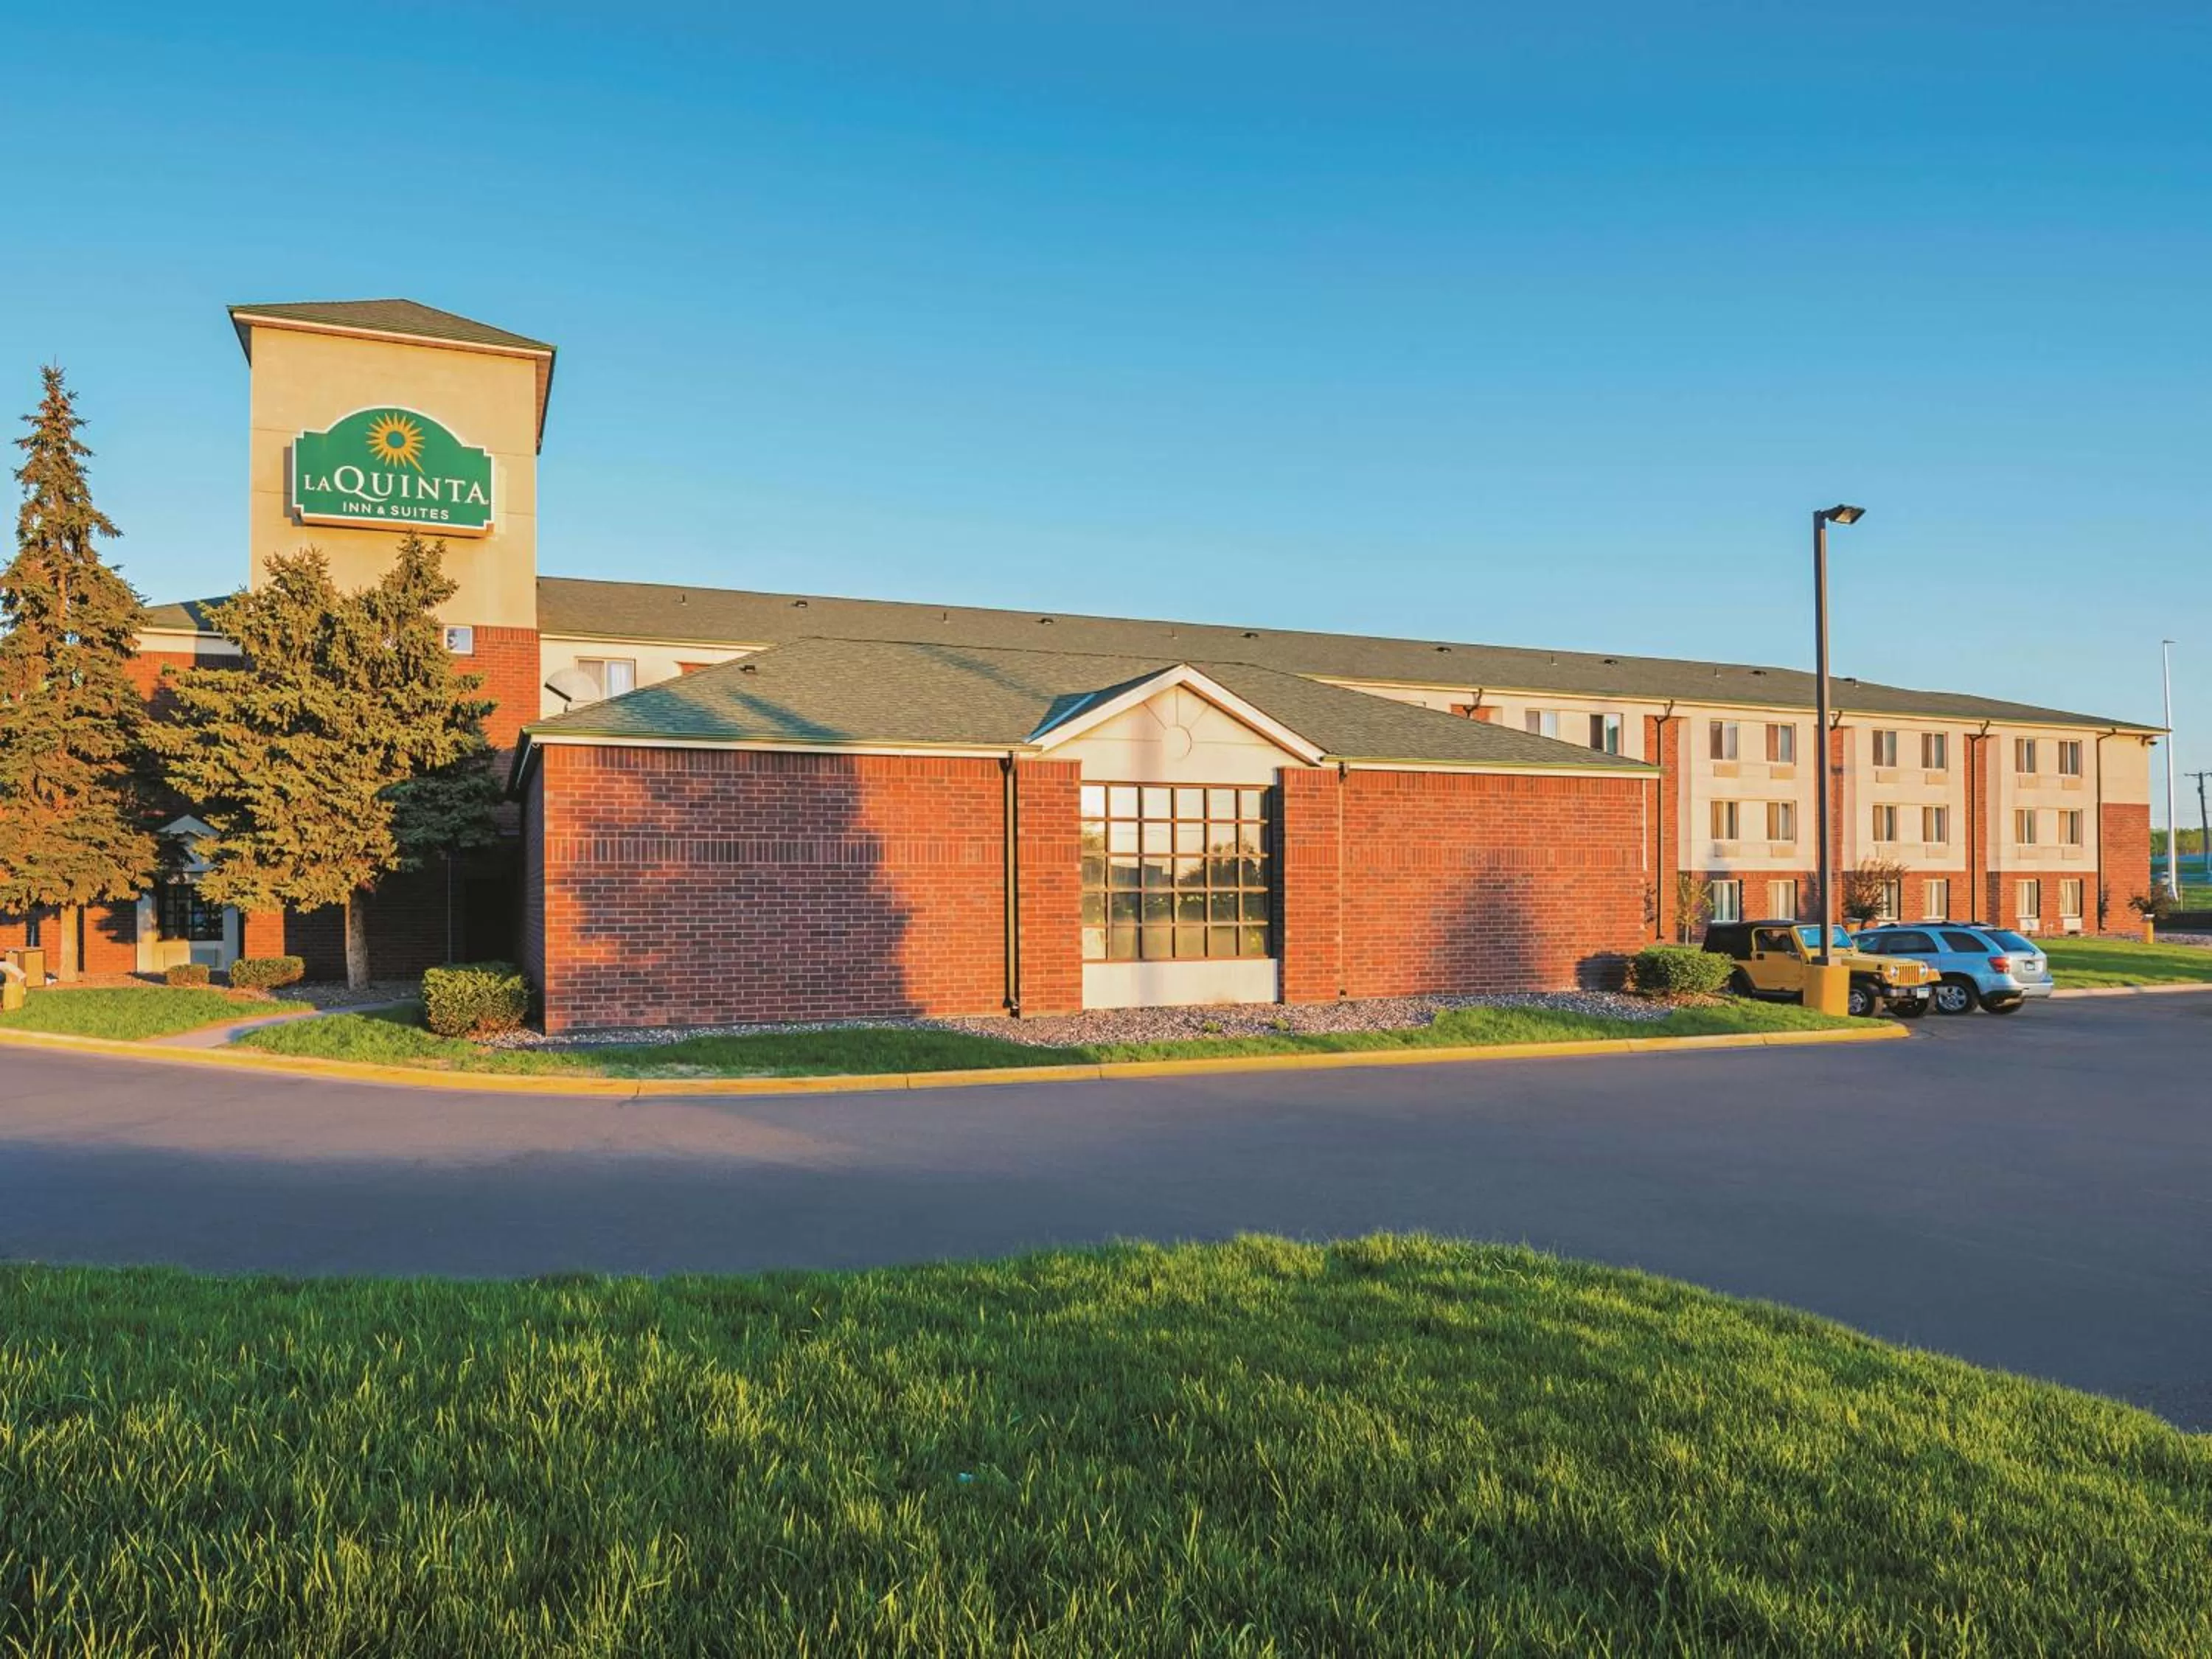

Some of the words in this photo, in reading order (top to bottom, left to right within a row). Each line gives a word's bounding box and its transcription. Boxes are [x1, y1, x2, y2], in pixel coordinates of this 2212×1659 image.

[305, 474, 332, 492] LA
[334, 465, 489, 504] QUINTA
[343, 501, 372, 514] INN
[377, 503, 385, 515] &
[390, 505, 449, 520] SUITES
